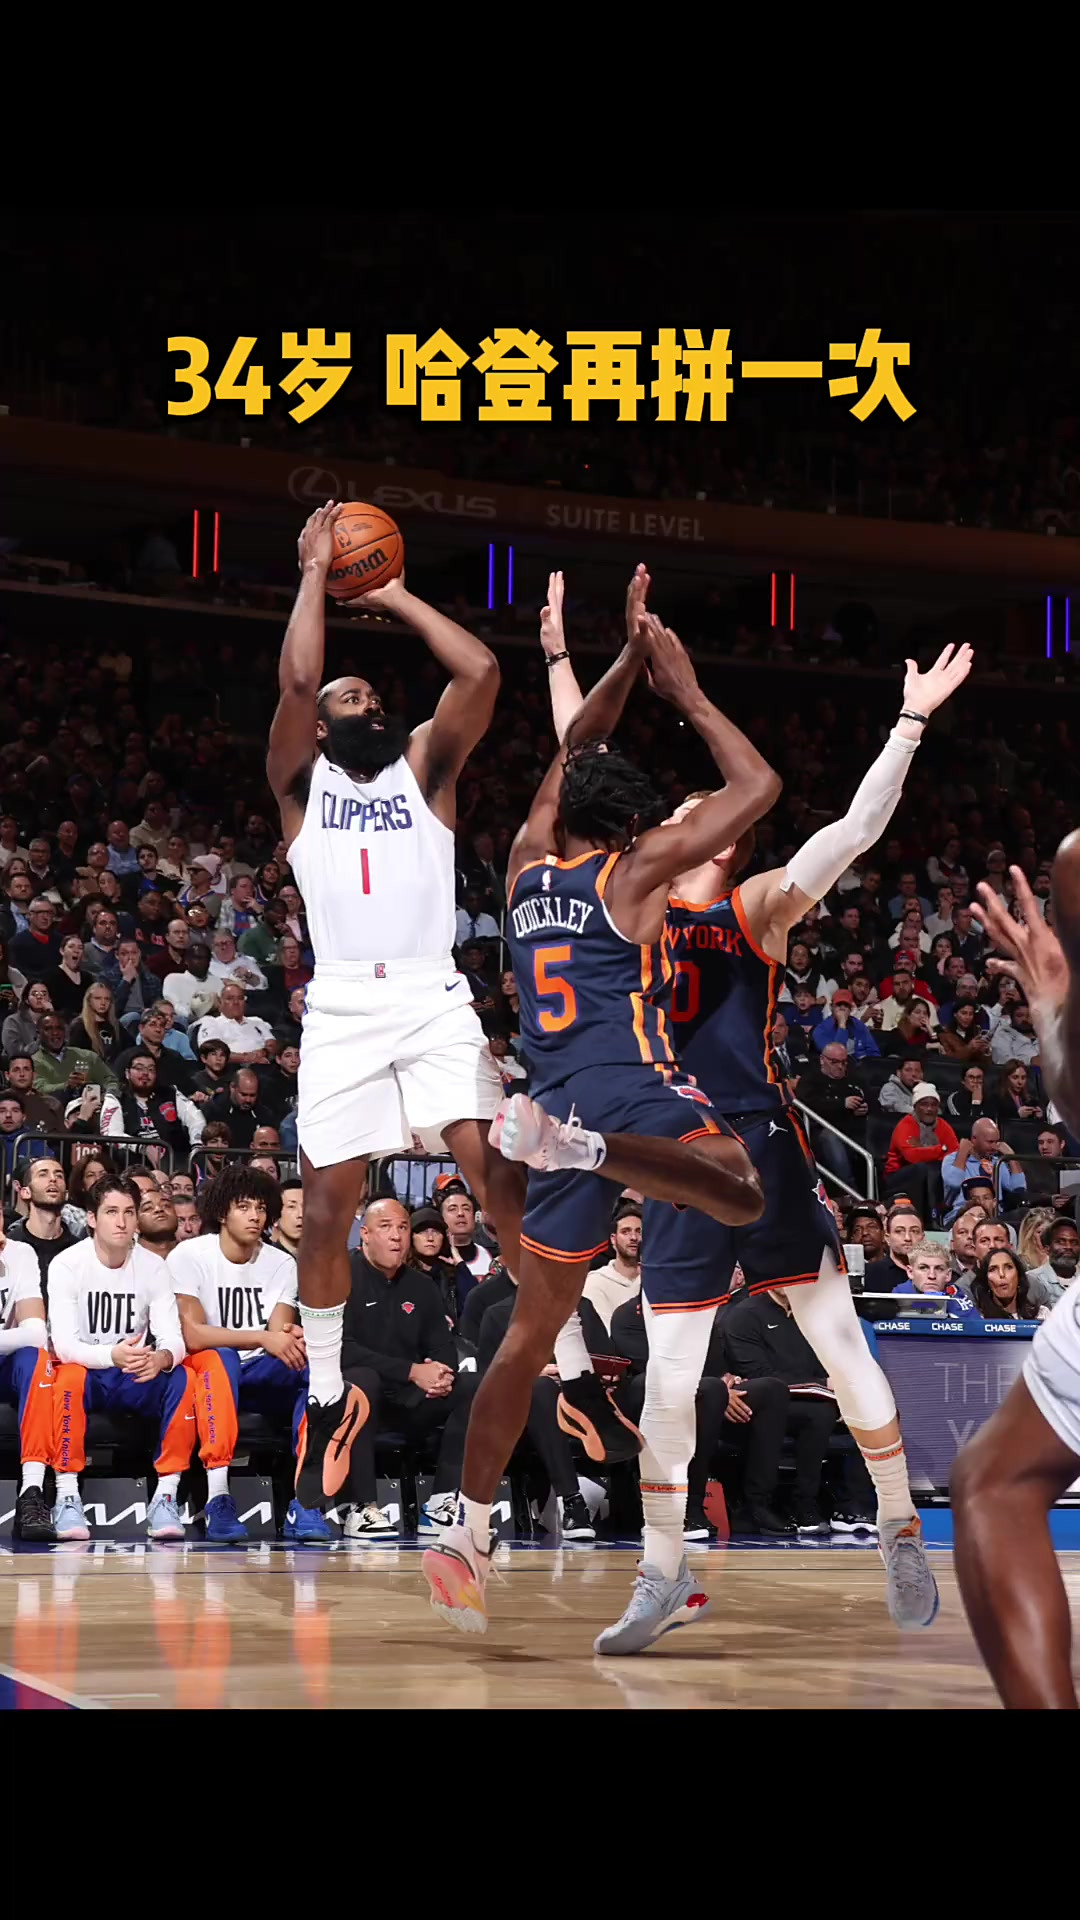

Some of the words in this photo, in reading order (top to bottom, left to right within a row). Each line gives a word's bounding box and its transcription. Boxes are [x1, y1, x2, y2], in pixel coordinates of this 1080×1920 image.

[347, 479, 497, 519] LEXUS
[545, 503, 621, 533] SUITE
[629, 511, 705, 542] LEVEL
[321, 790, 413, 833] CLIPPERS
[360, 847, 371, 895] 1
[511, 896, 594, 939] QUICKLEY
[532, 942, 578, 1033] 5
[87, 1291, 136, 1334] VOTE
[218, 1286, 268, 1329] VOTE
[878, 1322, 910, 1331] CHASE
[931, 1323, 964, 1331] CHASE
[984, 1324, 1017, 1333] CHASE
[63, 1390, 73, 1411] New
[62, 1415, 72, 1434] York
[61, 1437, 72, 1467] Knicks
